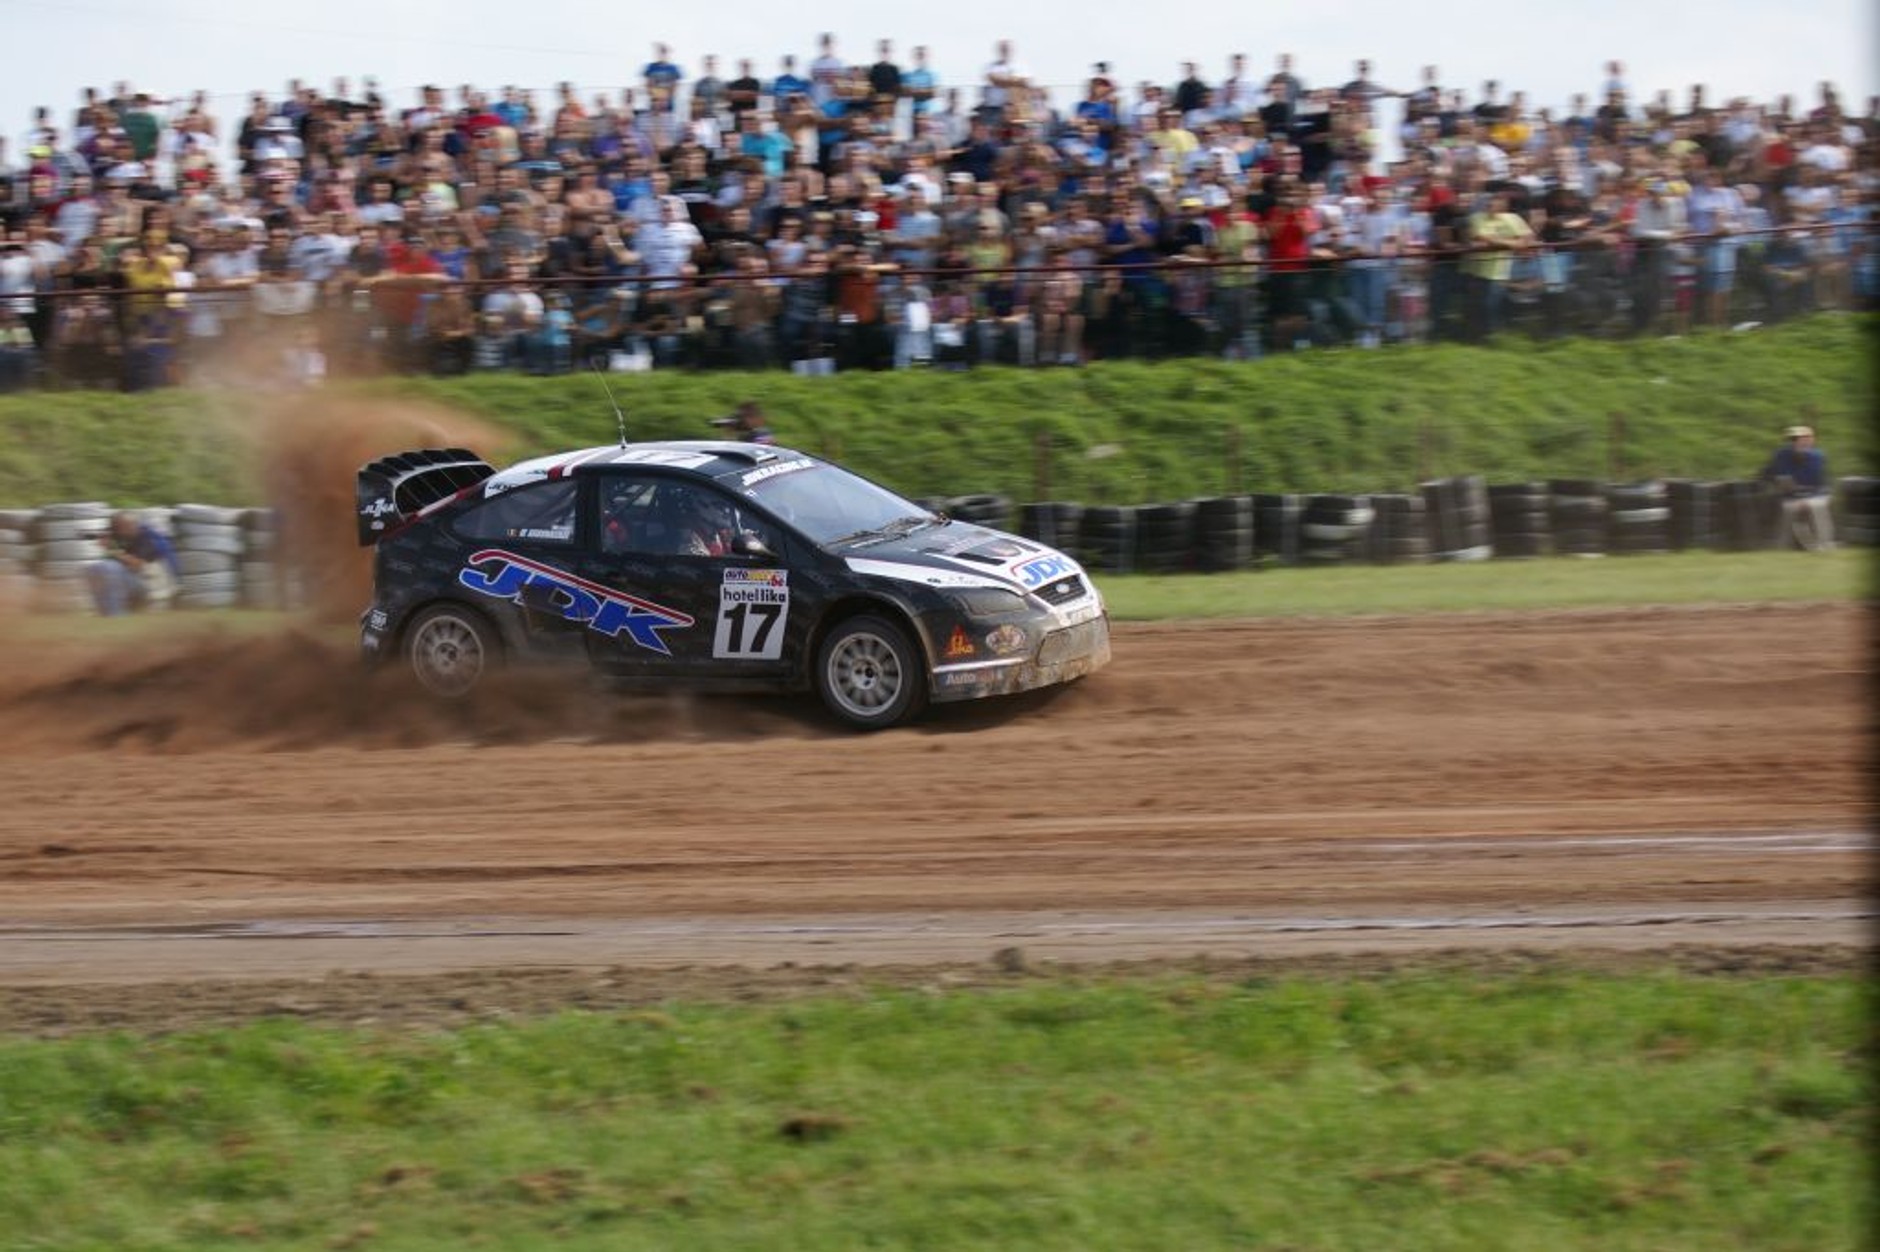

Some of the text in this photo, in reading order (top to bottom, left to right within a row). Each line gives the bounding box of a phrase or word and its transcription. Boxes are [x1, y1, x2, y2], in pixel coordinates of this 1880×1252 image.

[1021, 556, 1080, 586] JDK
[459, 550, 696, 656] JDK
[723, 603, 782, 652] 17
